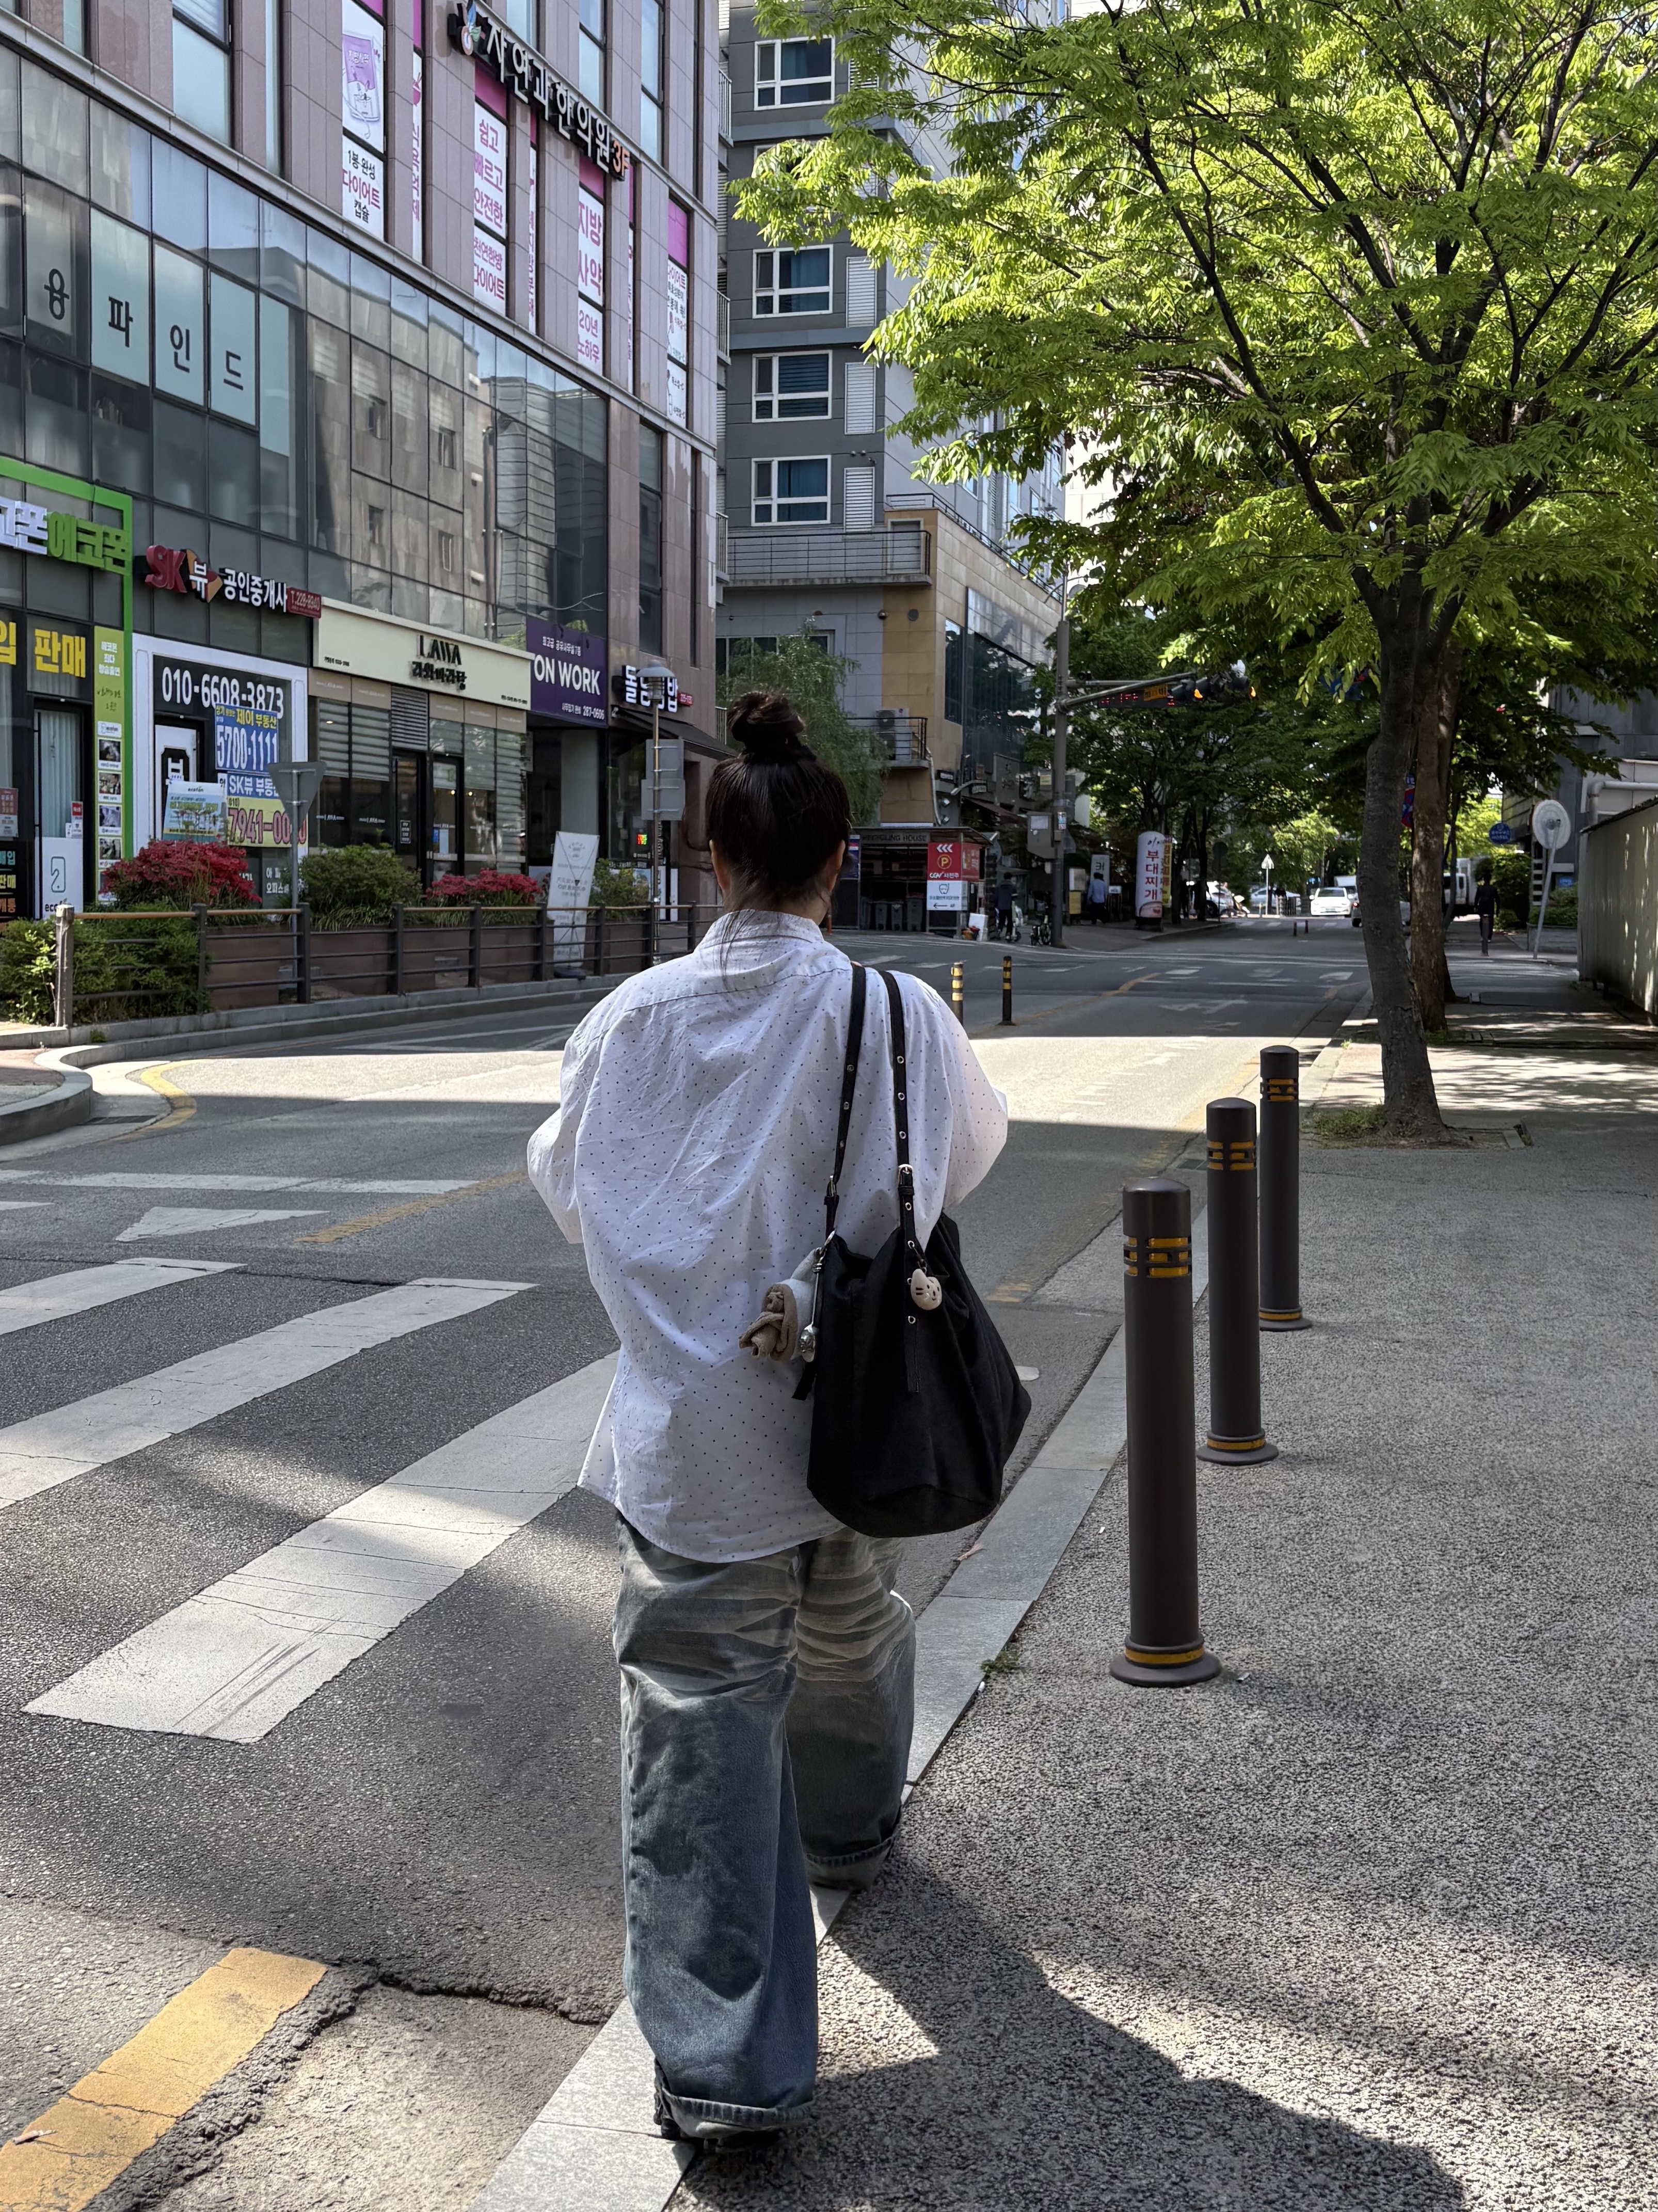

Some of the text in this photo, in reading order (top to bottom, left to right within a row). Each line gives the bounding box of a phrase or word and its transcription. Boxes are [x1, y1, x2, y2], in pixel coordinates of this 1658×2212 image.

[486, 24, 610, 173] 자연과한의원
[613, 140, 630, 177] 3F
[479, 119, 499, 153] 쉽고
[342, 168, 381, 210] 다이어트
[361, 157, 375, 180] 완성
[474, 152, 503, 193] 빠르고
[354, 198, 370, 224] 캡슐
[474, 187, 503, 229] 안전한
[579, 202, 602, 247] 지방
[474, 235, 502, 272] 천연한방
[474, 263, 505, 300] 다이어트
[579, 309, 598, 338] 20년
[578, 338, 599, 364] 노하우
[47, 511, 129, 576] 에코폰
[224, 568, 288, 613] 공인중개사
[35, 628, 86, 678] 판매
[162, 666, 284, 720] 010-6608-3873
[534, 654, 601, 695] ON WORK
[236, 708, 254, 726] 제이
[255, 713, 277, 729] 부동산
[229, 775, 253, 796] SK뷰
[228, 807, 307, 845] 7941-000
[1144, 850, 1159, 900] 부대찌개
